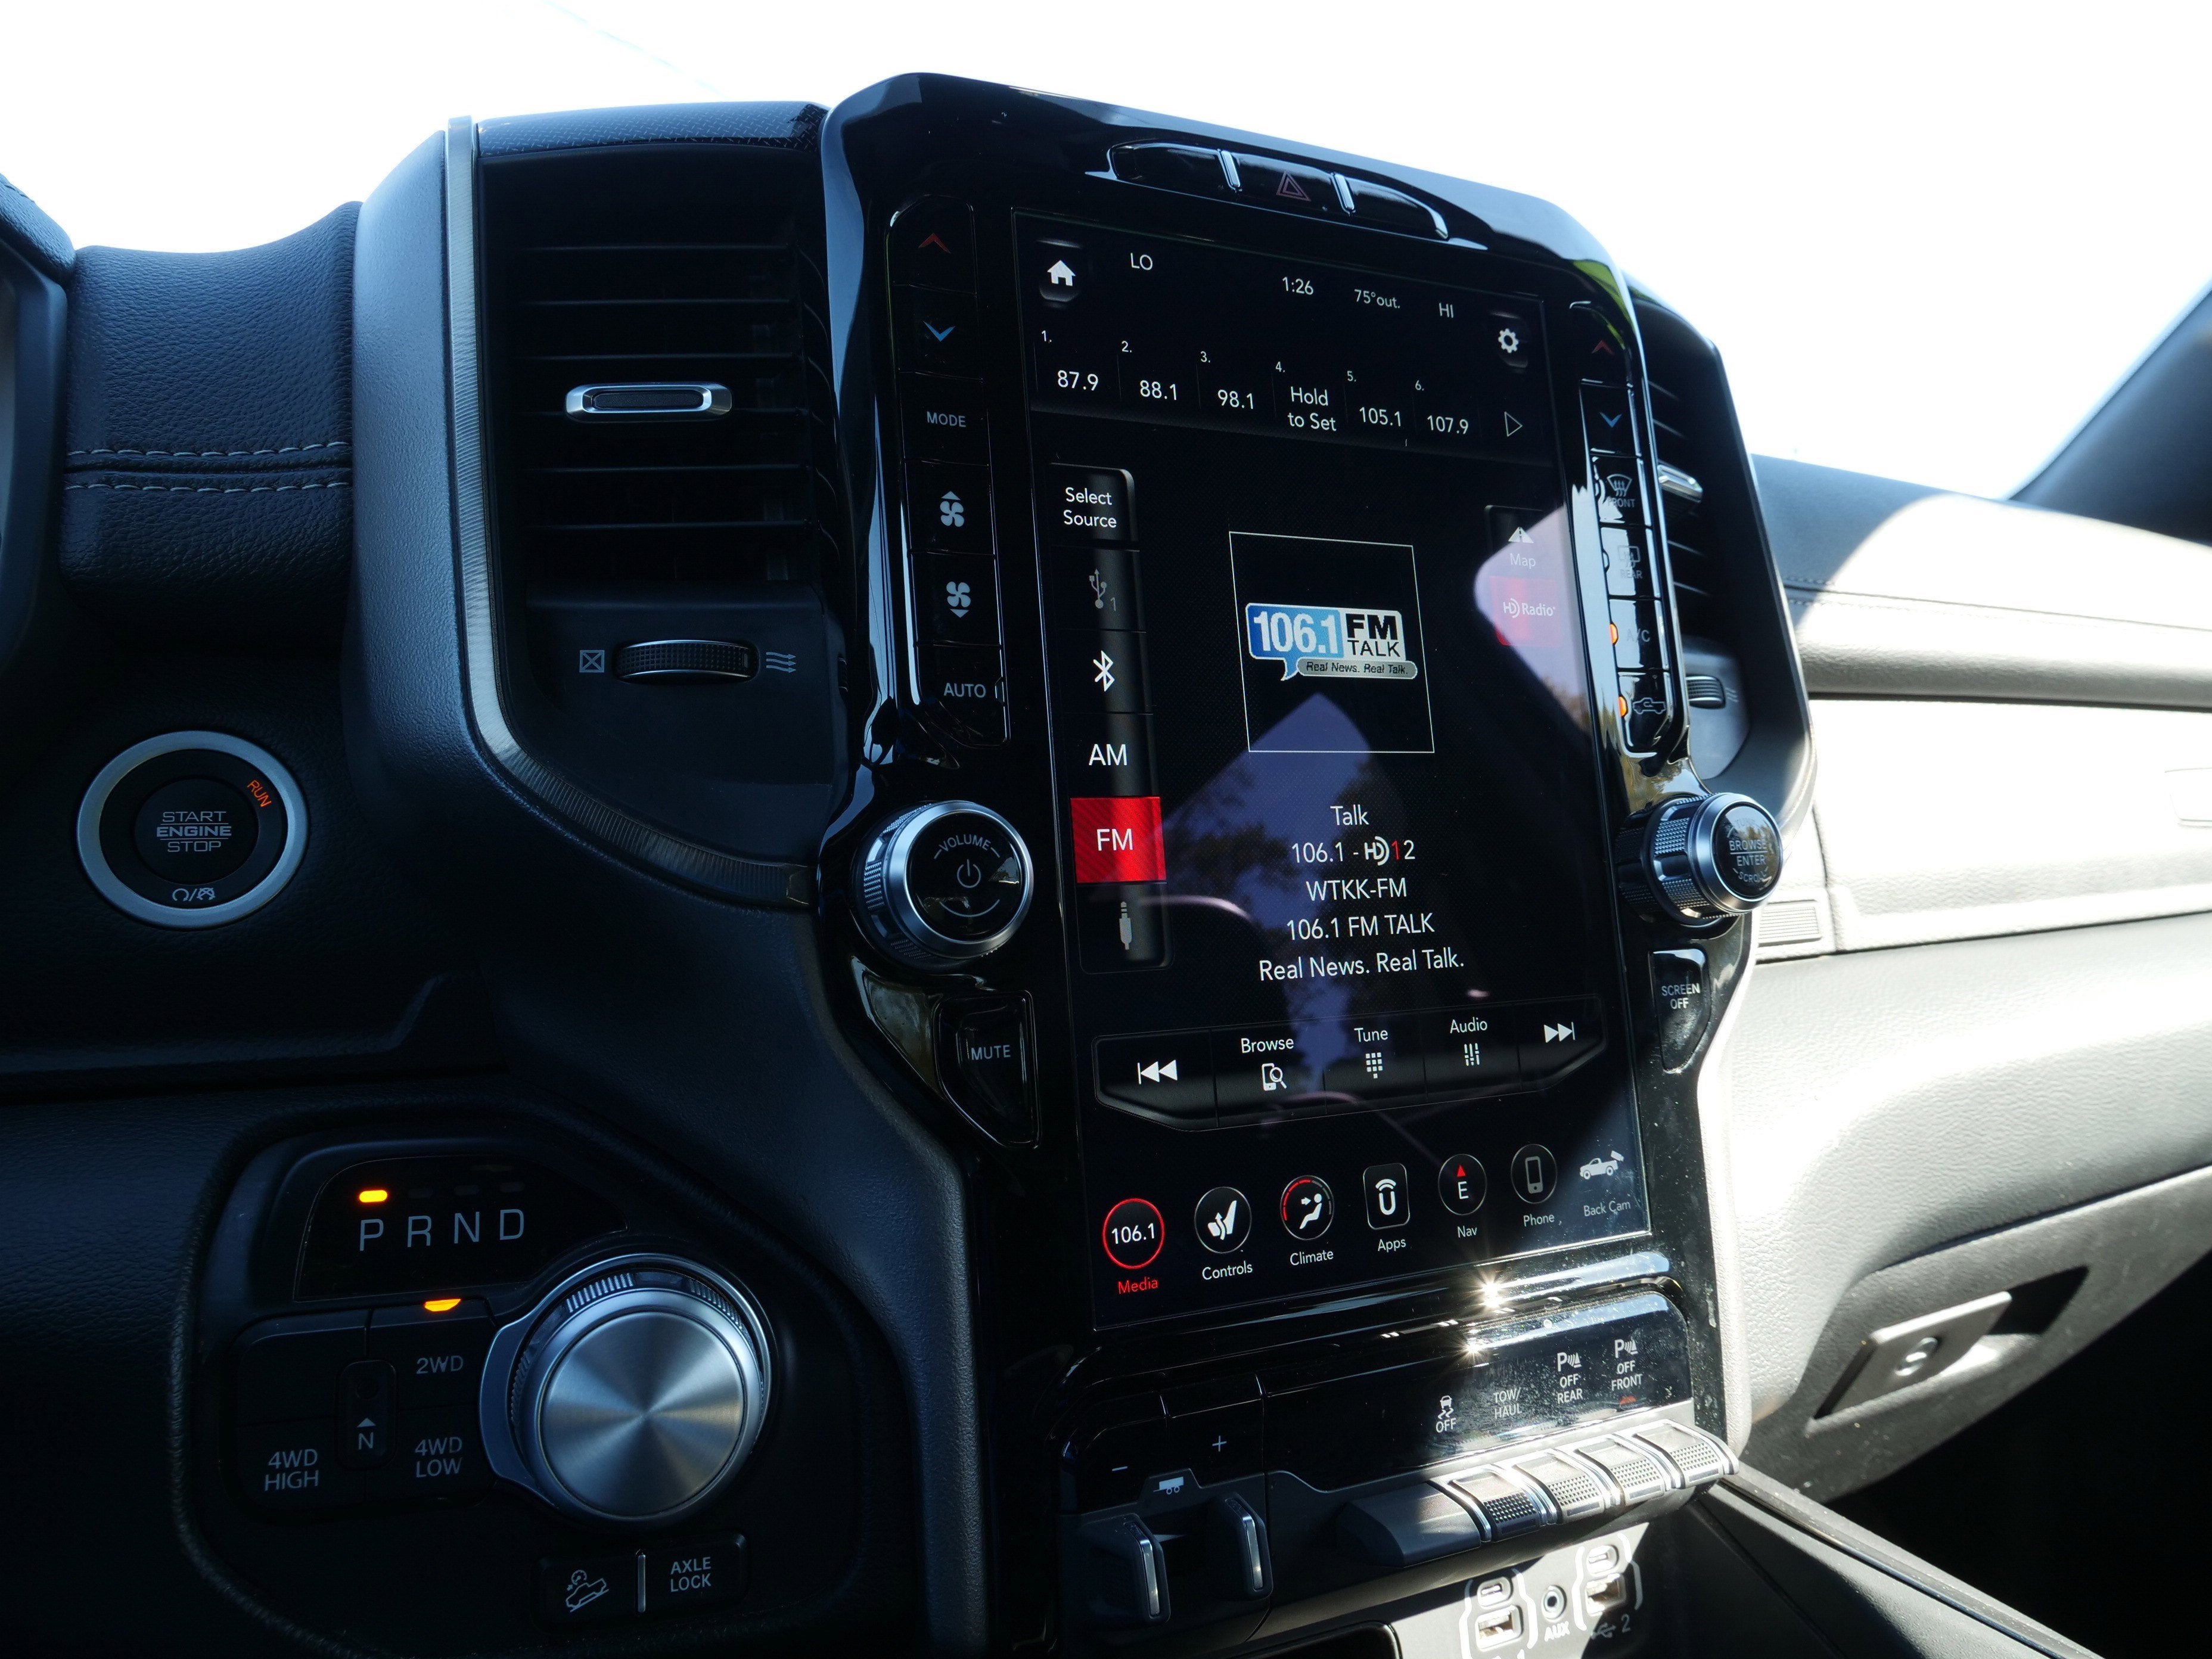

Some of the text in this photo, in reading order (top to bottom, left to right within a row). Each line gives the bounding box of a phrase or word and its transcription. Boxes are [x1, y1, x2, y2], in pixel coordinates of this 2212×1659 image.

[1130, 253, 1153, 271] LO
[1282, 276, 1313, 294] 1:26
[1439, 303, 1454, 318] HI
[1041, 330, 1052, 343] 1.
[1121, 340, 1132, 353] 2.
[1200, 351, 1211, 363] 3.
[1275, 361, 1285, 373] 4.
[1057, 370, 1098, 391] 87.9
[1347, 371, 1356, 382] 5.
[1139, 380, 1178, 400] 88.1
[1415, 380, 1424, 391] 6.
[1217, 389, 1254, 409] 98.1
[1290, 386, 1328, 406] Hold
[927, 411, 967, 428] MODE
[1288, 412, 1337, 431] to Set
[1359, 407, 1402, 427] 105.1
[1427, 415, 1469, 434] 107.9
[1065, 487, 1113, 505] Select
[1607, 496, 1636, 508] FRONT
[1063, 510, 1117, 528] Source
[1510, 553, 1536, 569] Map
[1620, 570, 1642, 579] REAR
[1110, 597, 1116, 611] 1
[1254, 611, 1398, 654] 106.1 FM
[1626, 629, 1651, 642] A/C
[1347, 640, 1400, 657] TALK
[1306, 661, 1408, 675] Real News. Real Talk.
[944, 682, 986, 698] AUTO
[1089, 744, 1127, 766] AM
[247, 779, 272, 807] RUN
[163, 811, 226, 822] START
[1330, 804, 1369, 826] Talk
[157, 825, 232, 837] ENGINE
[1096, 828, 1133, 851] FM
[167, 841, 221, 852] STOP
[939, 834, 991, 853] VOLUME
[1729, 839, 1767, 851] BROWSE
[1292, 842, 1343, 863] 106.1
[1736, 855, 1766, 866] ENTER
[1306, 877, 1407, 901] WTKK-FM
[1287, 912, 1435, 940] 106.1 FM TALK
[1259, 947, 1464, 981] Real News. Real Talk.
[1661, 983, 1700, 996] SCREEN
[1670, 997, 1688, 1009] OFF
[1450, 1017, 1488, 1034] Audio
[1354, 1027, 1388, 1043] Tune
[971, 1045, 1011, 1060] MUTE
[1241, 1037, 1294, 1054] Browse
[1458, 1180, 1469, 1200] E
[1583, 1199, 1631, 1217] Back Cam
[1523, 1213, 1555, 1227] Phone
[359, 1208, 524, 1251] P R N D
[1111, 1222, 1155, 1245] 106.1
[1457, 1225, 1478, 1238] Nav
[1378, 1237, 1406, 1253] Apps
[1290, 1250, 1334, 1266] Climate
[1202, 1260, 1253, 1281] Controls
[1118, 1277, 1158, 1294] Media
[417, 1355, 464, 1374] 2WD
[1617, 1360, 1636, 1375] OFF
[1560, 1374, 1579, 1388] OFF
[1611, 1374, 1642, 1391] FRONT
[1493, 1387, 1520, 1403] TOW/
[1558, 1388, 1583, 1404] REAR
[1495, 1404, 1522, 1419] HAUL
[1436, 1418, 1456, 1433] OFF
[358, 1433, 374, 1450] N
[415, 1436, 462, 1456] 4WD
[268, 1448, 318, 1470] 4WD
[417, 1458, 462, 1478] LOW
[265, 1470, 319, 1491] HIGH
[670, 1557, 712, 1575] AXLE
[670, 1573, 712, 1592] LOCK
[1545, 1621, 1570, 1641] AUX
[1621, 1614, 1631, 1633] 2
